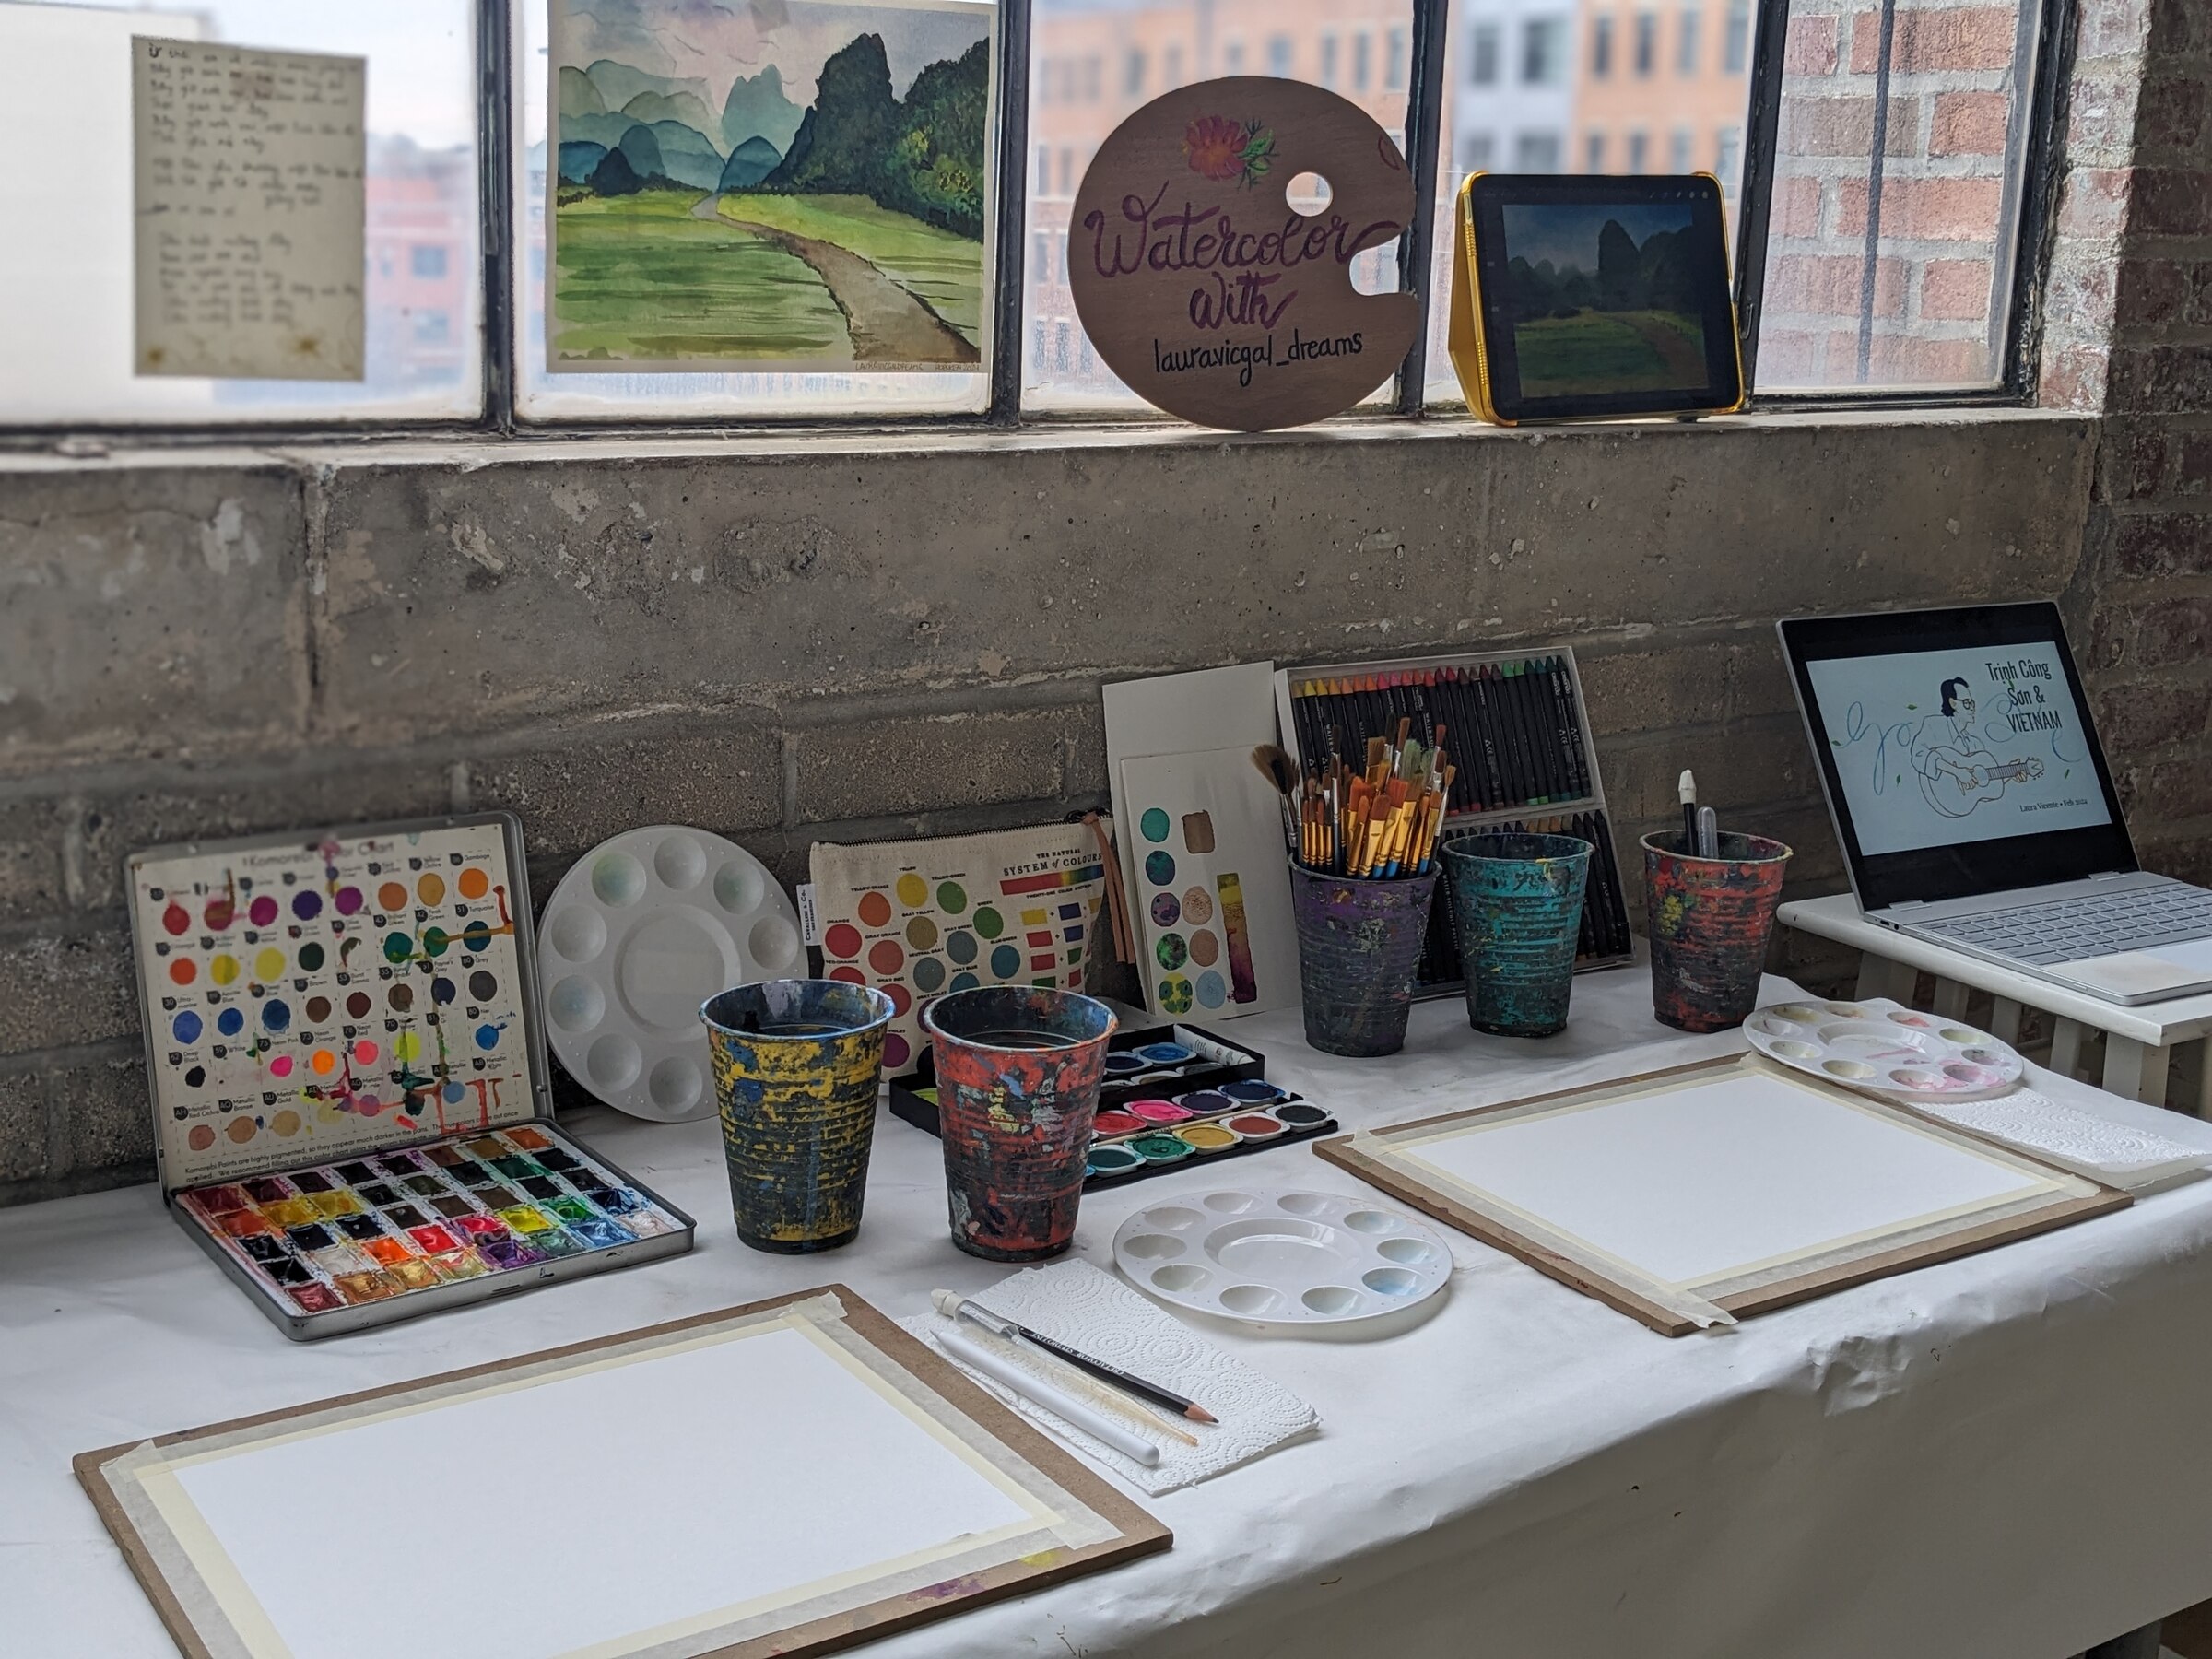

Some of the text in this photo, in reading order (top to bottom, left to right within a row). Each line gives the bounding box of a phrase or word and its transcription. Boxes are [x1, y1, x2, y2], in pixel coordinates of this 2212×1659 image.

[1084, 180, 1401, 278] Watercolor
[1154, 327, 1370, 388] lauravicgal_dreams
[1985, 659, 2052, 684] Trịnh Công
[2033, 685, 2046, 703] &
[2006, 710, 2063, 733] VIETNAM
[1052, 848, 1081, 857] NATURAL
[1003, 853, 1102, 876] SYSTEM of COLOURS
[185, 1162, 218, 1174] Komorebi
[251, 1155, 270, 1164] highly
[317, 1143, 330, 1151] they
[332, 1139, 355, 1149] appear
[374, 1133, 395, 1141] darker
[231, 1163, 271, 1174] recommend
